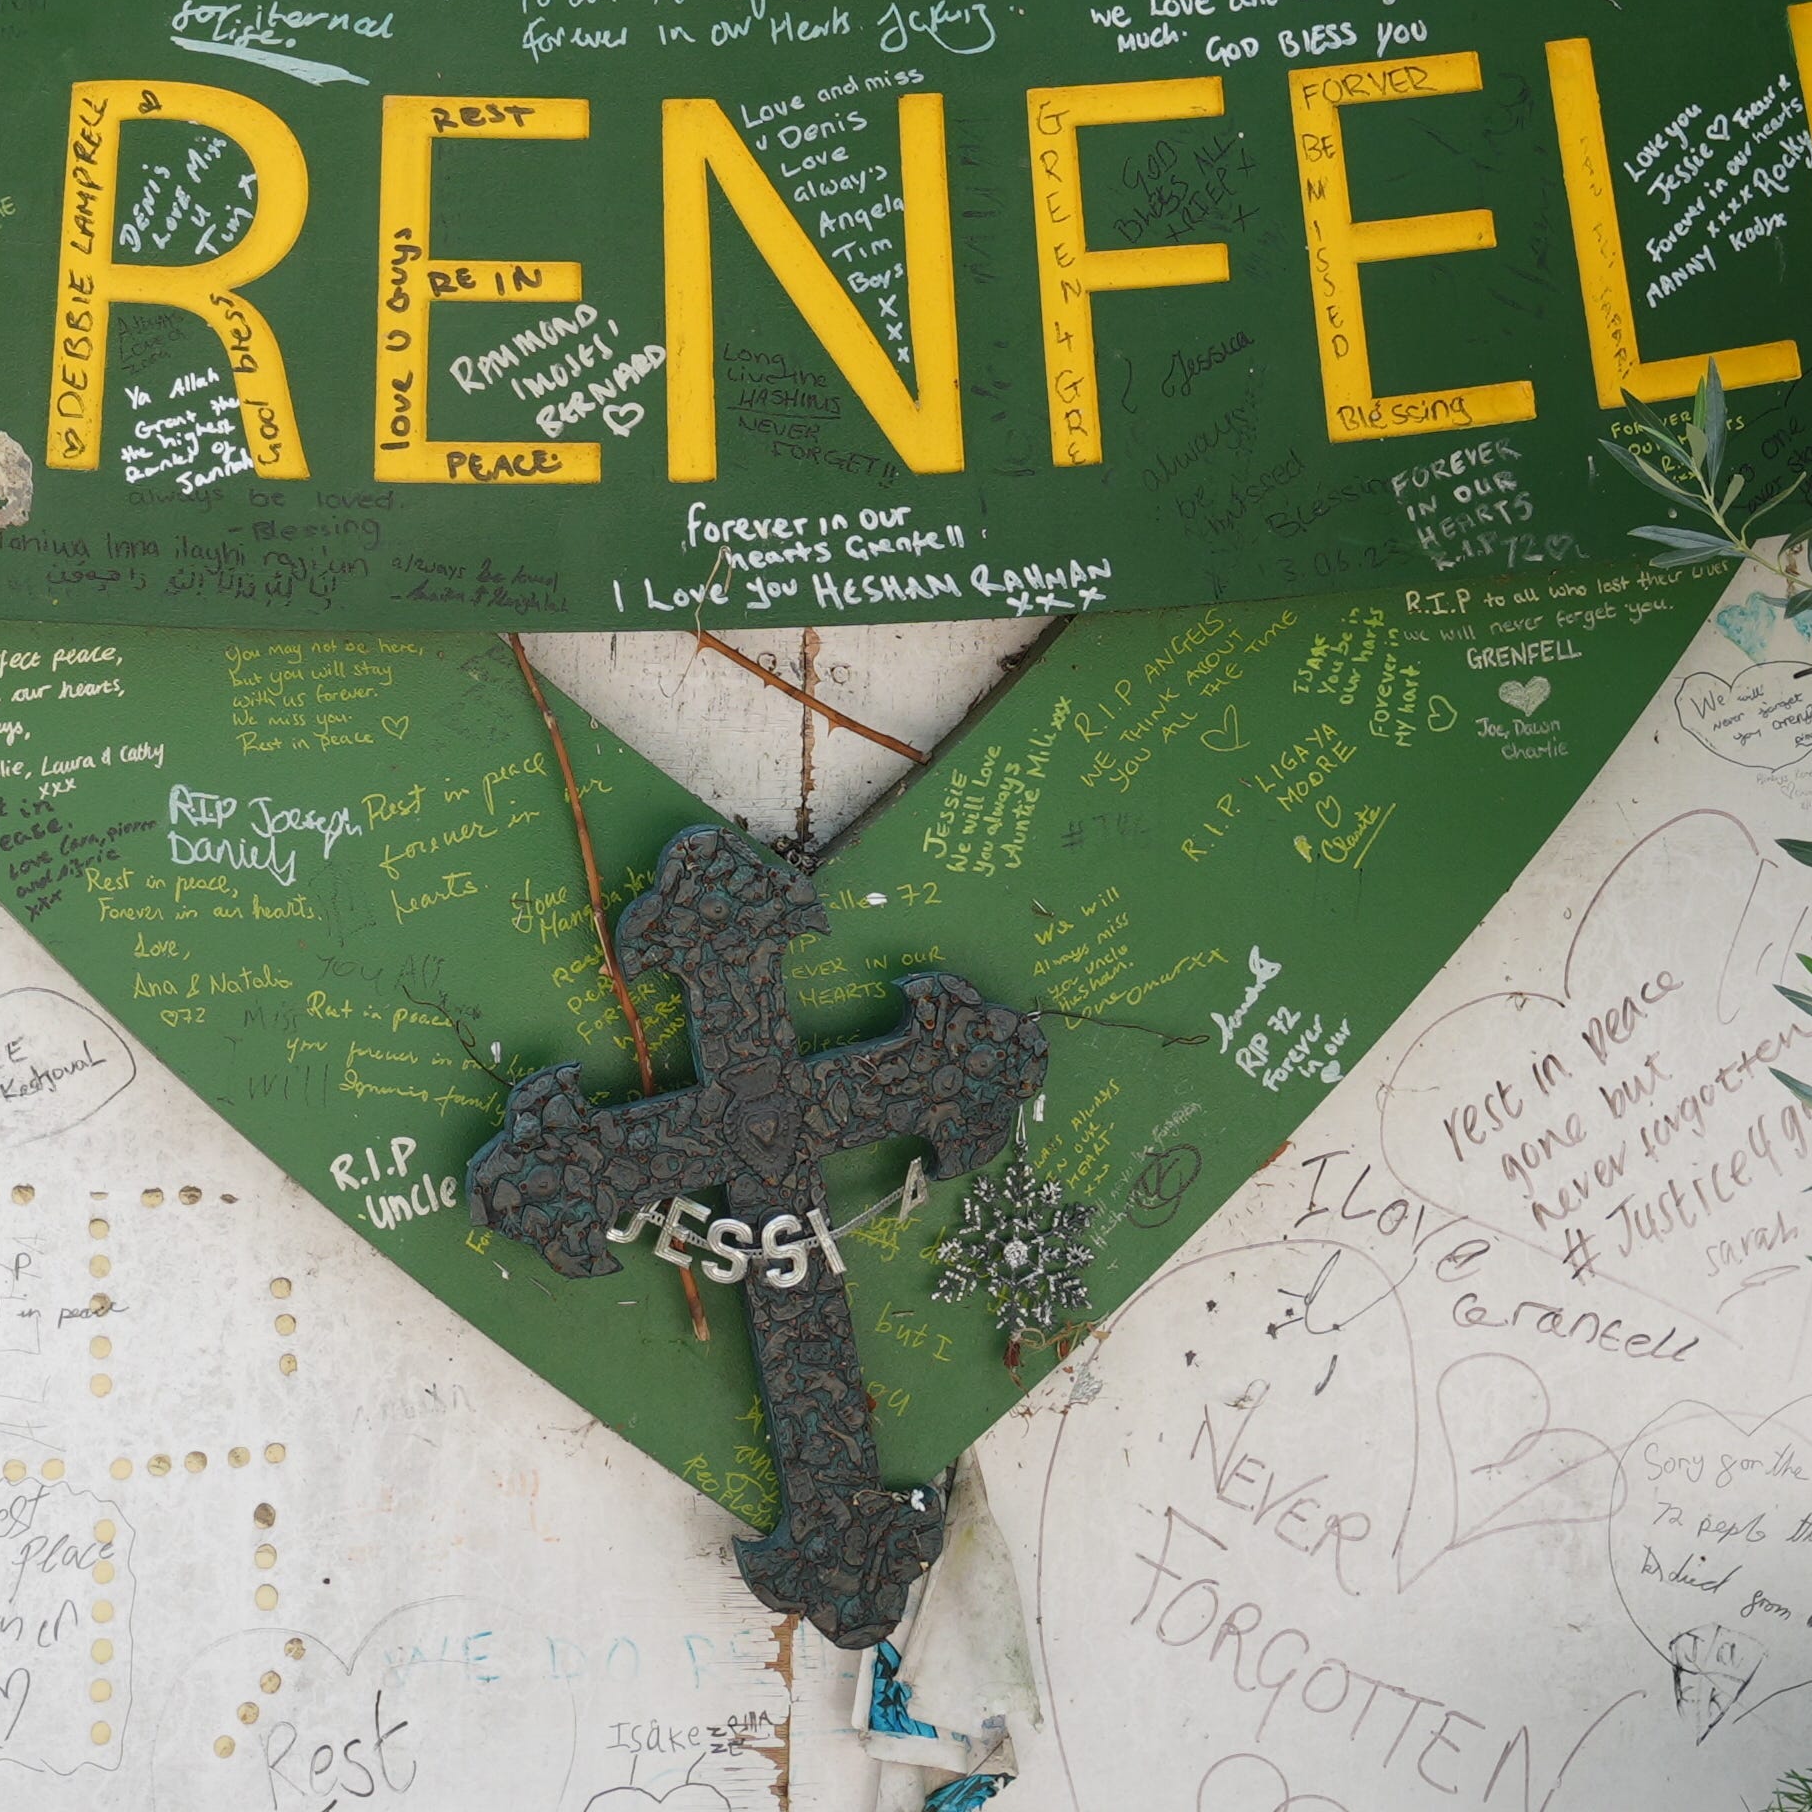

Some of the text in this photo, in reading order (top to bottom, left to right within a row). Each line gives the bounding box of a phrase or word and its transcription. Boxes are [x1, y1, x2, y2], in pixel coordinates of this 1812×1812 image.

[430, 106, 536, 133] REST
[818, 194, 906, 238] Angela
[832, 237, 893, 263] Tim
[496, 266, 543, 296] IN
[57, 272, 96, 419] DEBBIE
[1337, 396, 1474, 433] Blessing
[818, 512, 849, 532] in
[726, 537, 832, 572] hearts
[613, 579, 626, 613] I
[644, 579, 730, 611] Love
[746, 573, 799, 609] you
[813, 568, 960, 611] HESHAM
[1440, 966, 1688, 1161] rest in peace
[1190, 1381, 1373, 1600] NEVER
[1128, 1501, 1648, 1812] FORGOTTEN
